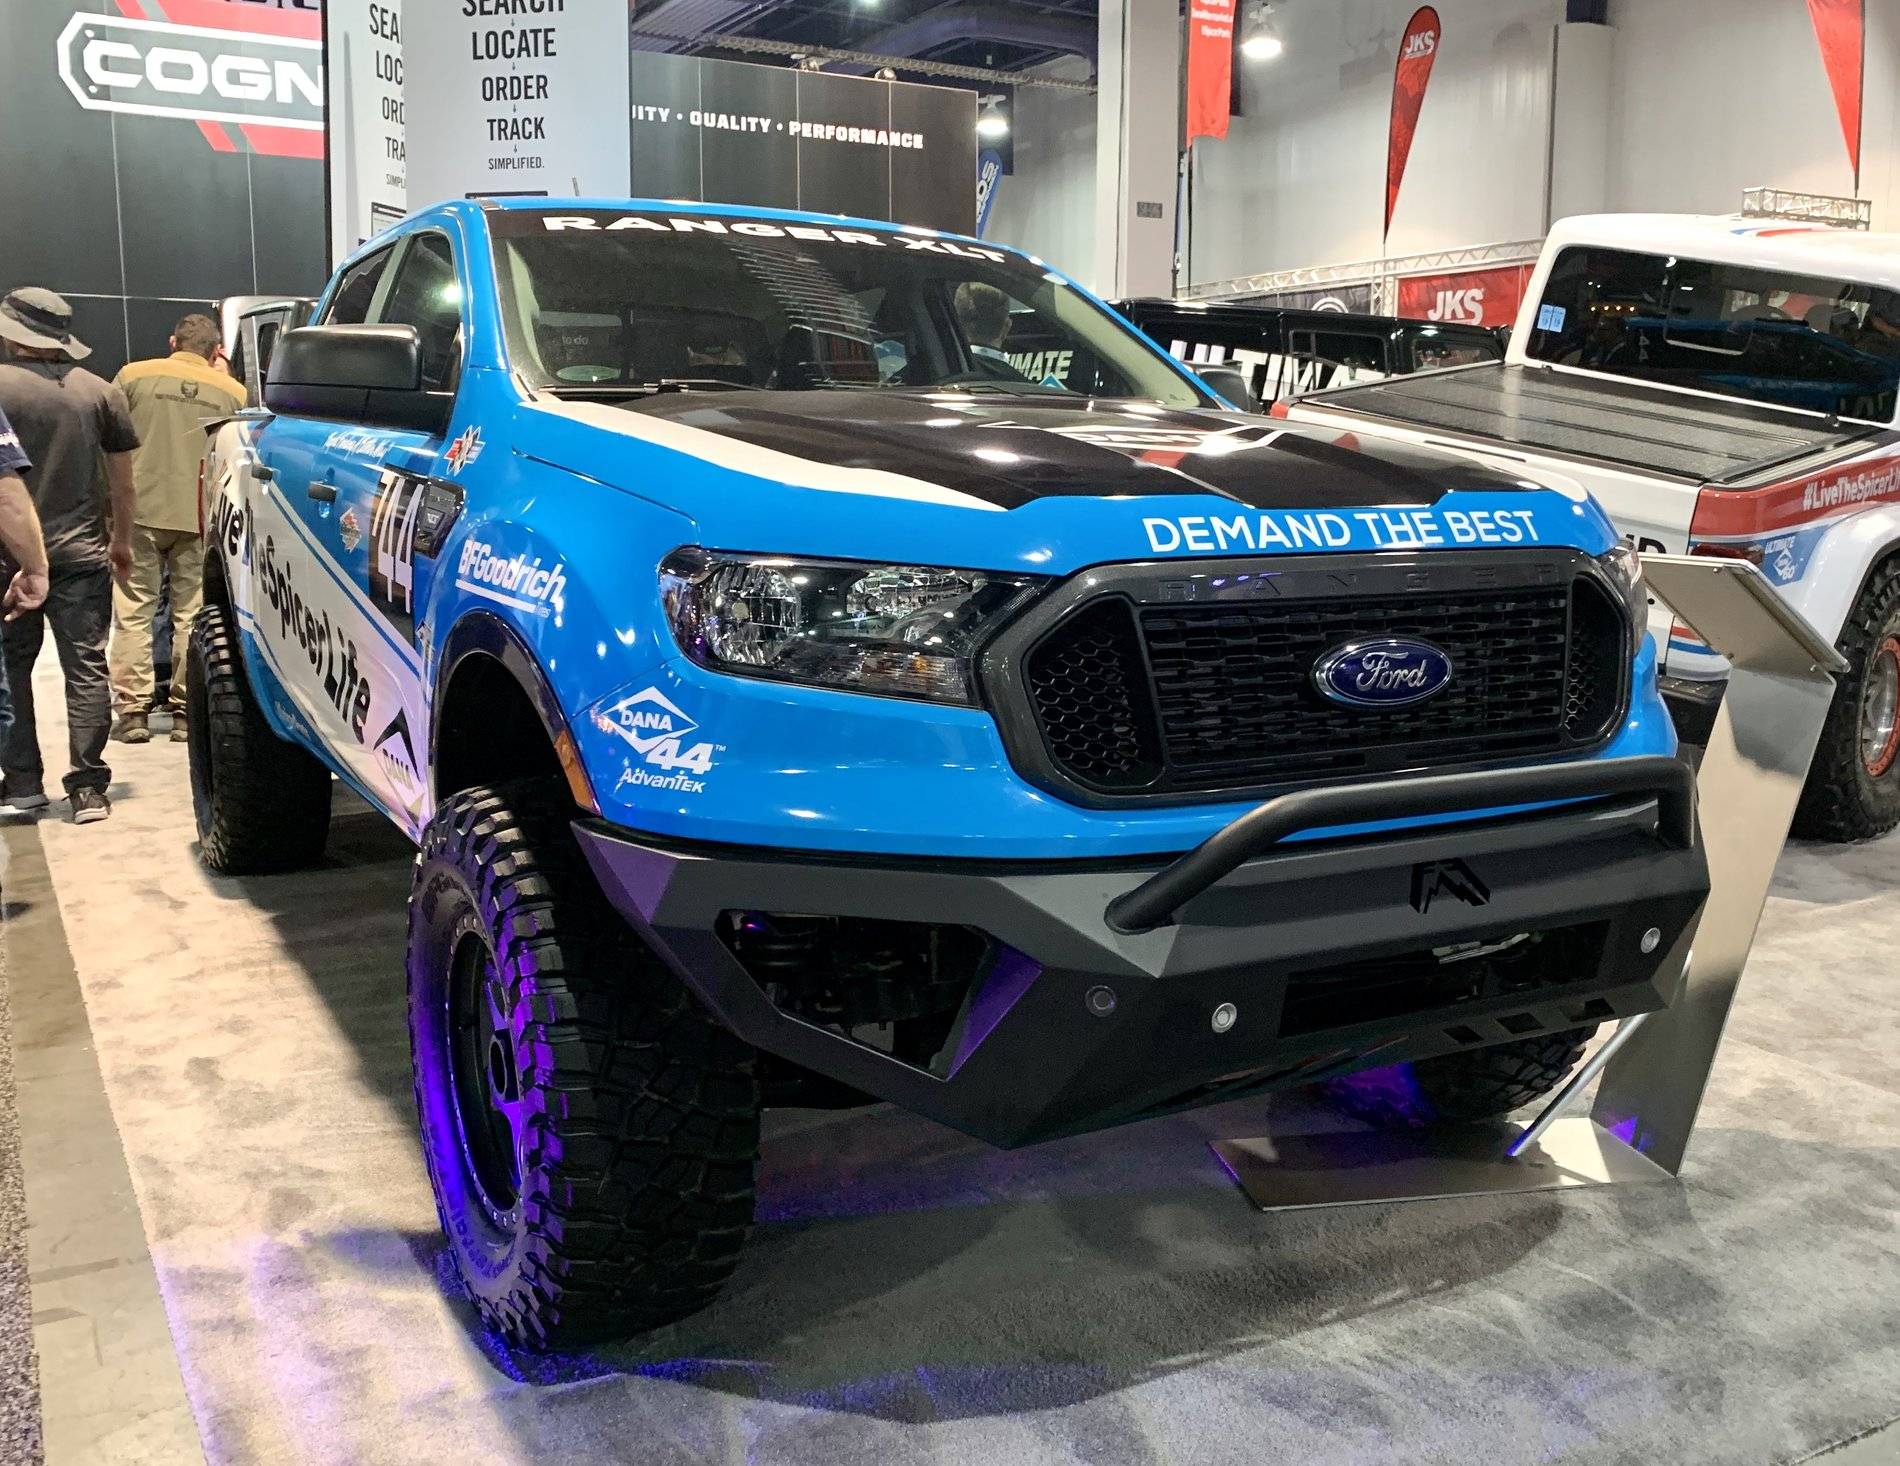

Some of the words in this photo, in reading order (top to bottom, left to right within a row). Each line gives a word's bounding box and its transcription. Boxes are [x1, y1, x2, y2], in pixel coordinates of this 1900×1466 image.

[472, 28, 557, 60] LOCATE
[1405, 30, 1435, 54] JKS
[482, 75, 549, 101] ORDER
[487, 117, 545, 141] TRACK
[689, 110, 772, 133] QUALITY
[789, 121, 924, 149] PERFORMANCE
[488, 157, 545, 170] SIMPLIFIED.
[542, 216, 887, 247] RANGER
[894, 237, 1006, 263] XLT
[1427, 288, 1484, 326] JKS
[1803, 465, 1900, 511] #LiveTheSpicerLi
[1142, 513, 1351, 553] DEMAND
[1354, 511, 1444, 548] THE
[1443, 510, 1540, 543] BEST
[458, 540, 566, 604] BFGoodrich
[1356, 652, 1428, 692] Ford
[620, 709, 673, 732] DANA
[620, 767, 706, 793] AdvanTEK
